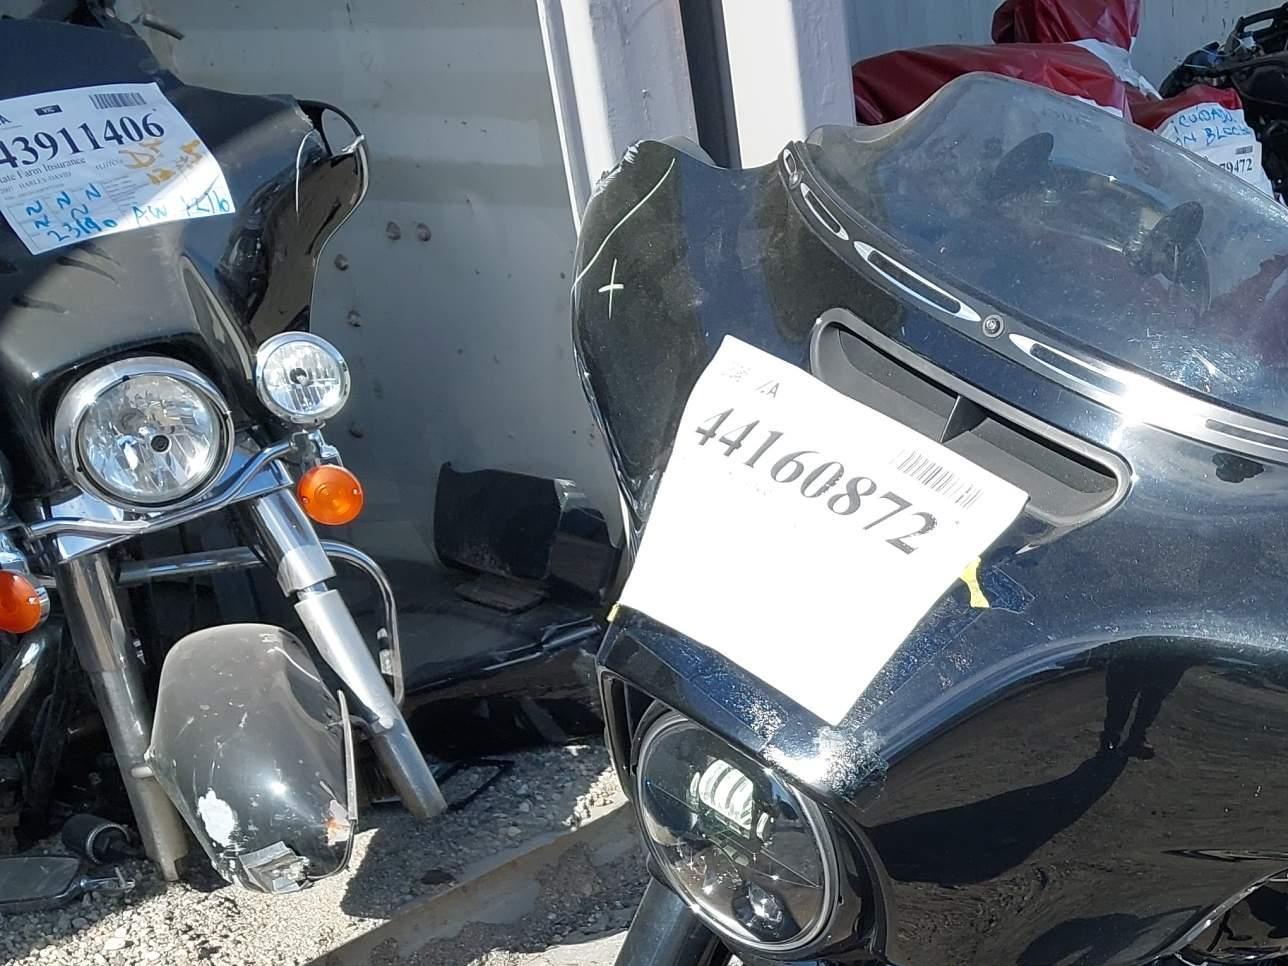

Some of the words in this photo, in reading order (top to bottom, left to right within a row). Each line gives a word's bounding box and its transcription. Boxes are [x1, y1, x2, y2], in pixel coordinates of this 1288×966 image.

[0, 113, 165, 168] 43911406
[43, 156, 86, 172] Insurance
[695, 407, 938, 556] 44160872
